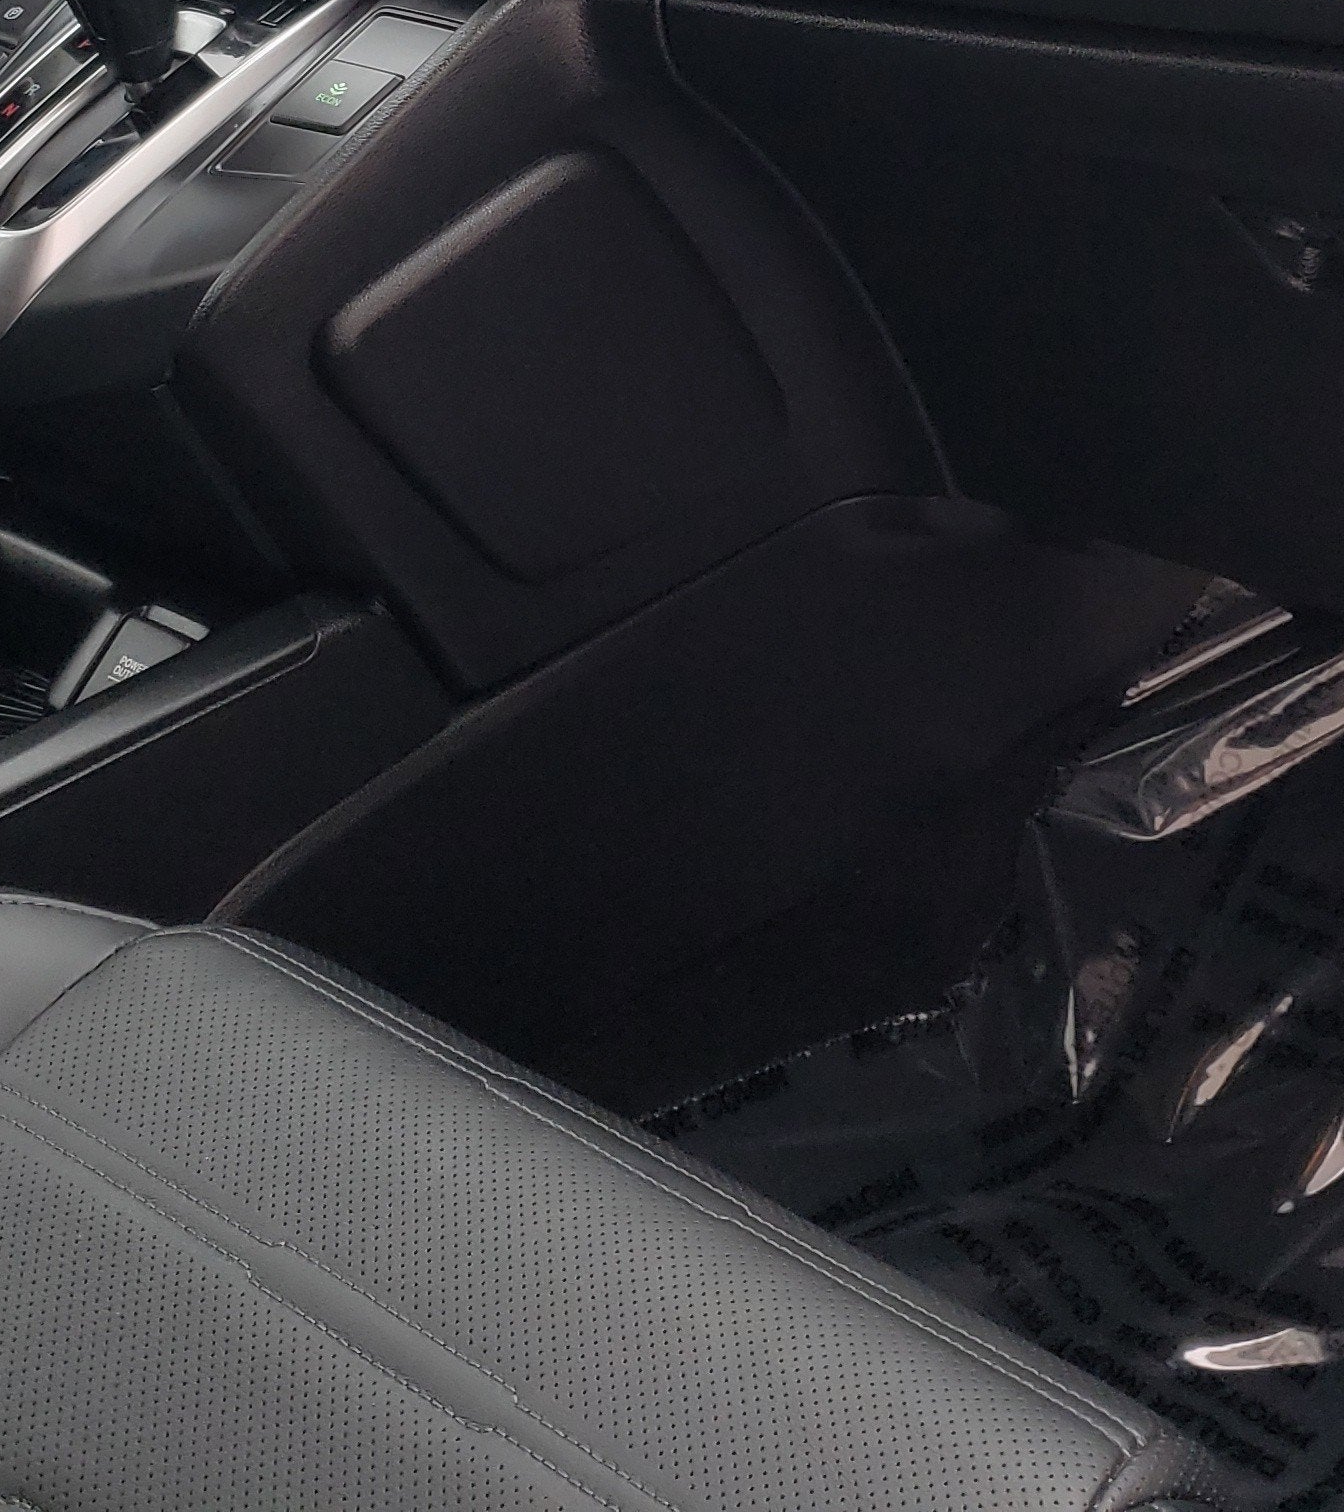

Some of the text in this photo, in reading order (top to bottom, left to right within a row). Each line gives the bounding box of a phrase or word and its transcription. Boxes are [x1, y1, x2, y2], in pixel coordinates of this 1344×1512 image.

[22, 82, 41, 97] R
[315, 92, 343, 107] ECON
[0, 102, 20, 117] N
